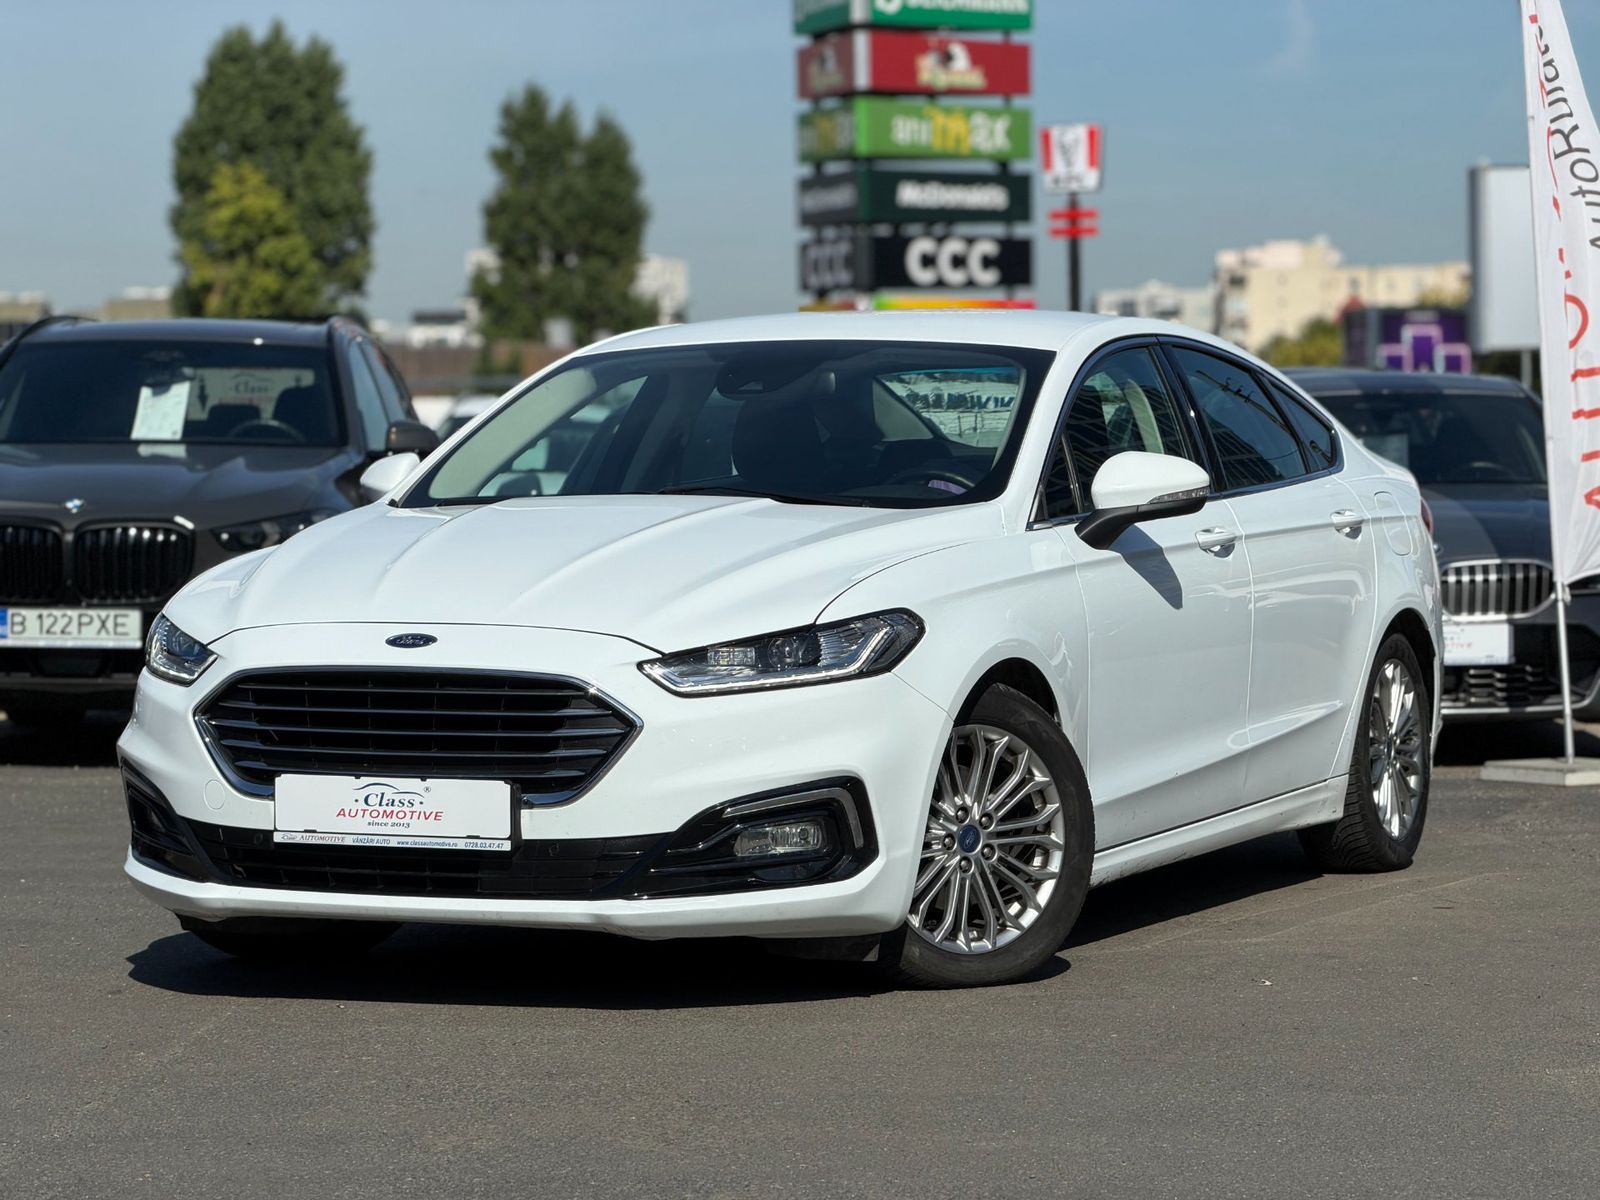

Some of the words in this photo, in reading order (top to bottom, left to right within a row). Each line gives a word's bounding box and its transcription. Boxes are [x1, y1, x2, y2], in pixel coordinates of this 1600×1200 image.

[904, 237, 1001, 287] CCC
[10, 613, 26, 635] B
[37, 613, 73, 635] 122
[77, 613, 129, 636] PXE
[363, 792, 415, 808] Class
[336, 807, 443, 821] AUTOMOTIVE
[300, 835, 346, 843] AUTOMOTIVE
